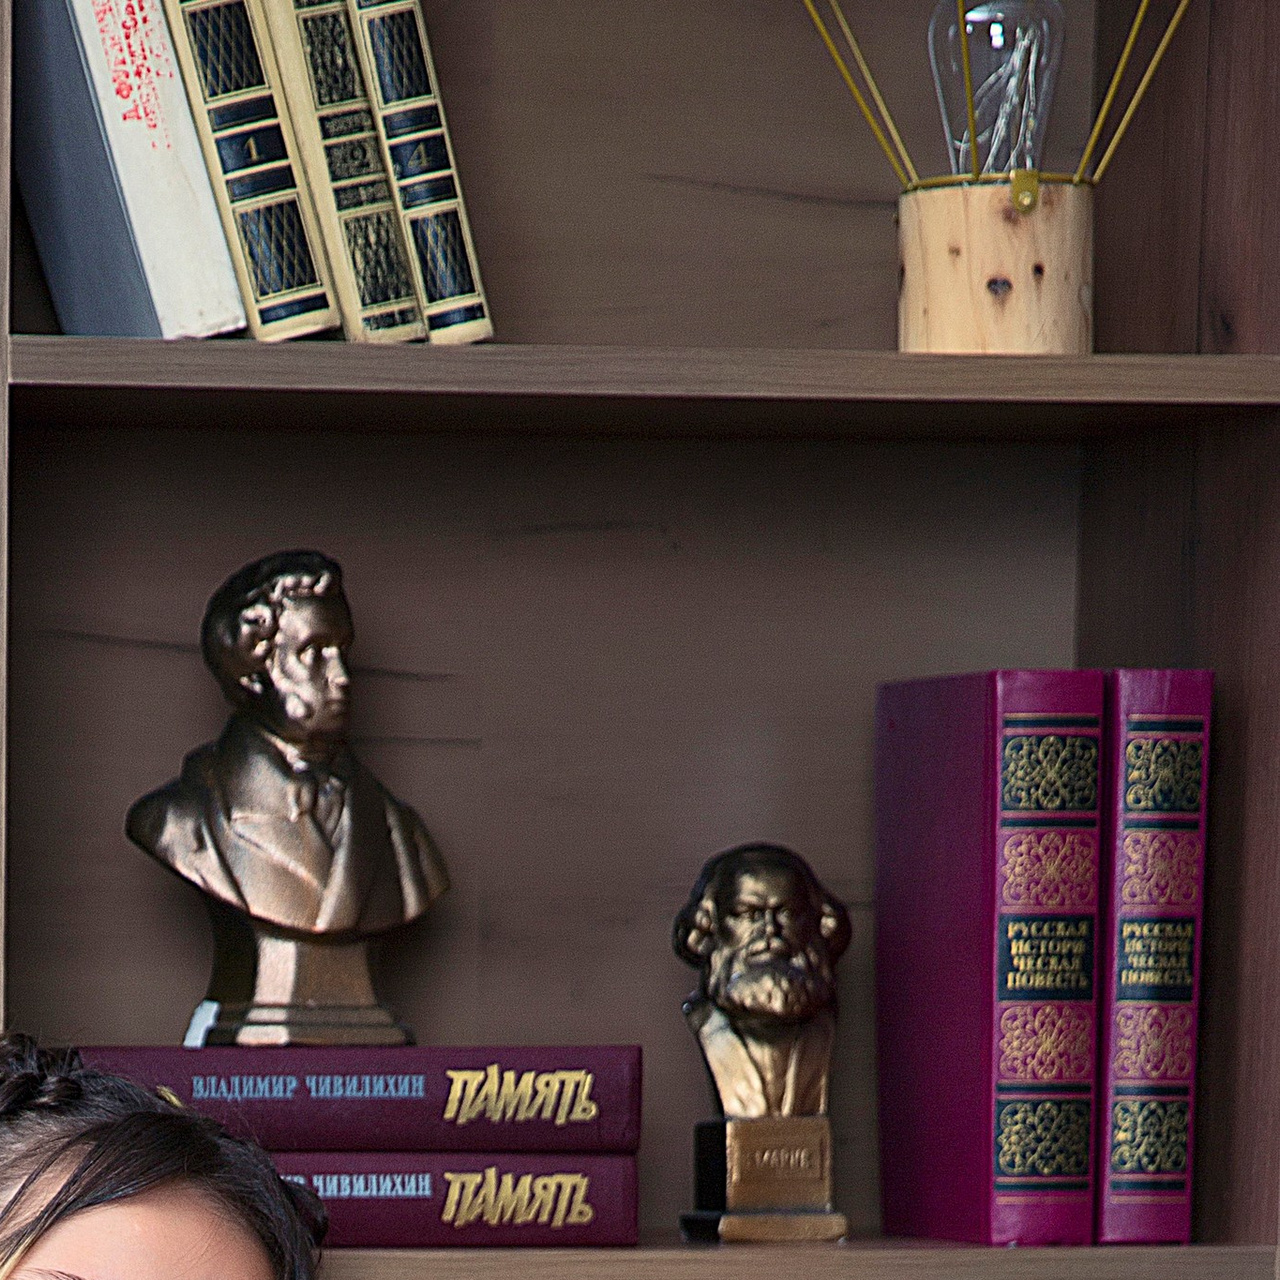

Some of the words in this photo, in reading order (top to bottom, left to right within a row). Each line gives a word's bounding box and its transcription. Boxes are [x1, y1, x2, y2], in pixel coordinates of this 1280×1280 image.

[243, 136, 260, 162] 1
[407, 142, 431, 168] 4
[192, 1074, 299, 1102] ВЛАДИМИР
[305, 1073, 427, 1100] ЧИВИЛИХИН
[443, 1063, 599, 1127] ПАМЯТЬ
[312, 1172, 433, 1199] ЧИВИЛИХИН
[441, 1166, 594, 1229] ПАМЯТЬ
